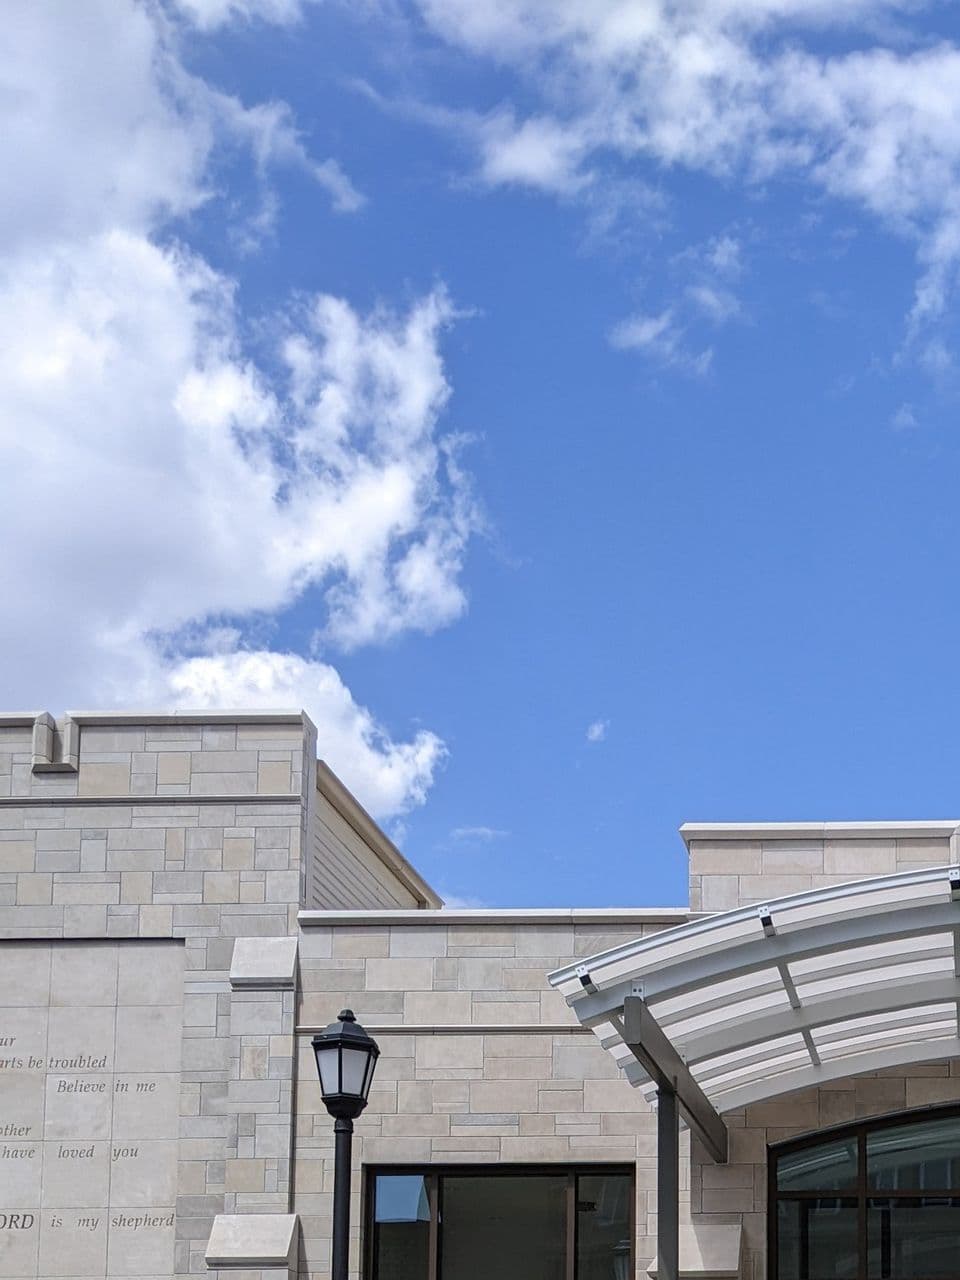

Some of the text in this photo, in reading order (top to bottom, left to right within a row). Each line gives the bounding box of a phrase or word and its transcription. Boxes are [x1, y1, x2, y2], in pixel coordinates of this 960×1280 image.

[28, 1056, 43, 1069] be
[48, 1056, 107, 1069] troubled
[57, 1080, 156, 1093] Believe in me
[2, 1145, 139, 1161] have loved you
[51, 1215, 63, 1228] is
[78, 1217, 99, 1231] my
[112, 1213, 175, 1231] shepherd
